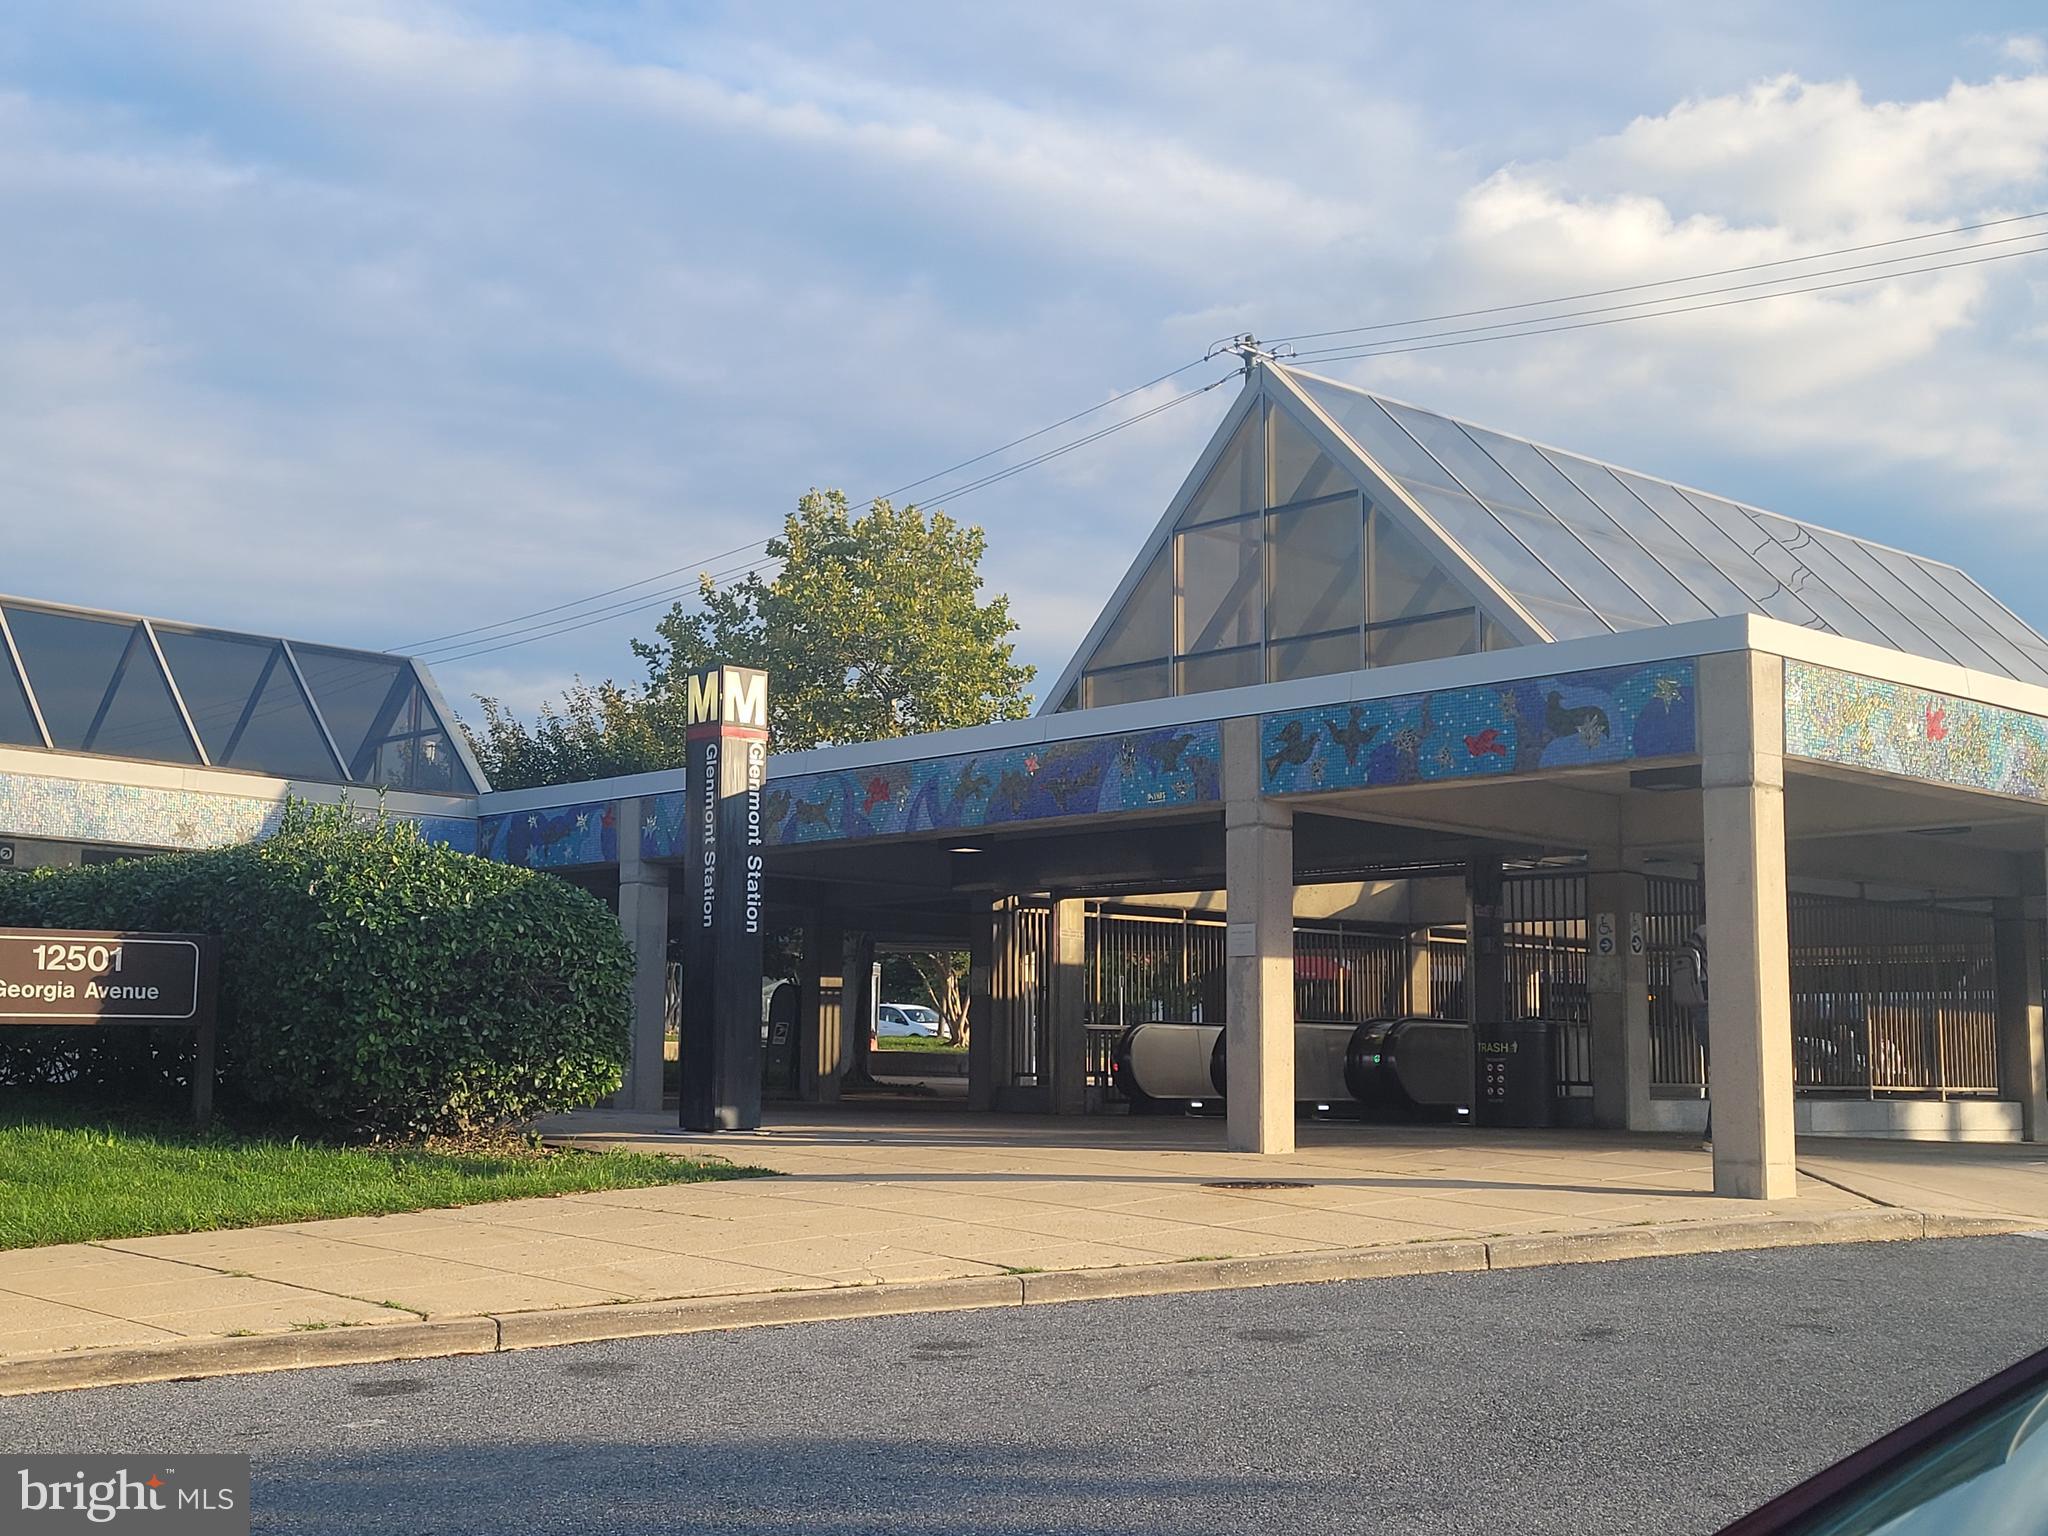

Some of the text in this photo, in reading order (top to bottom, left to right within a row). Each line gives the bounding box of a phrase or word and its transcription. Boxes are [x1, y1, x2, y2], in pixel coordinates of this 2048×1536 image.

[688, 671, 718, 725] M
[725, 671, 766, 726] M
[703, 743, 718, 927] Glenmont Station
[746, 742, 765, 933] Glenmont Station
[33, 944, 123, 972] 12501
[84, 981, 160, 999] Avenue
[1477, 1042, 1509, 1053] TRASH
